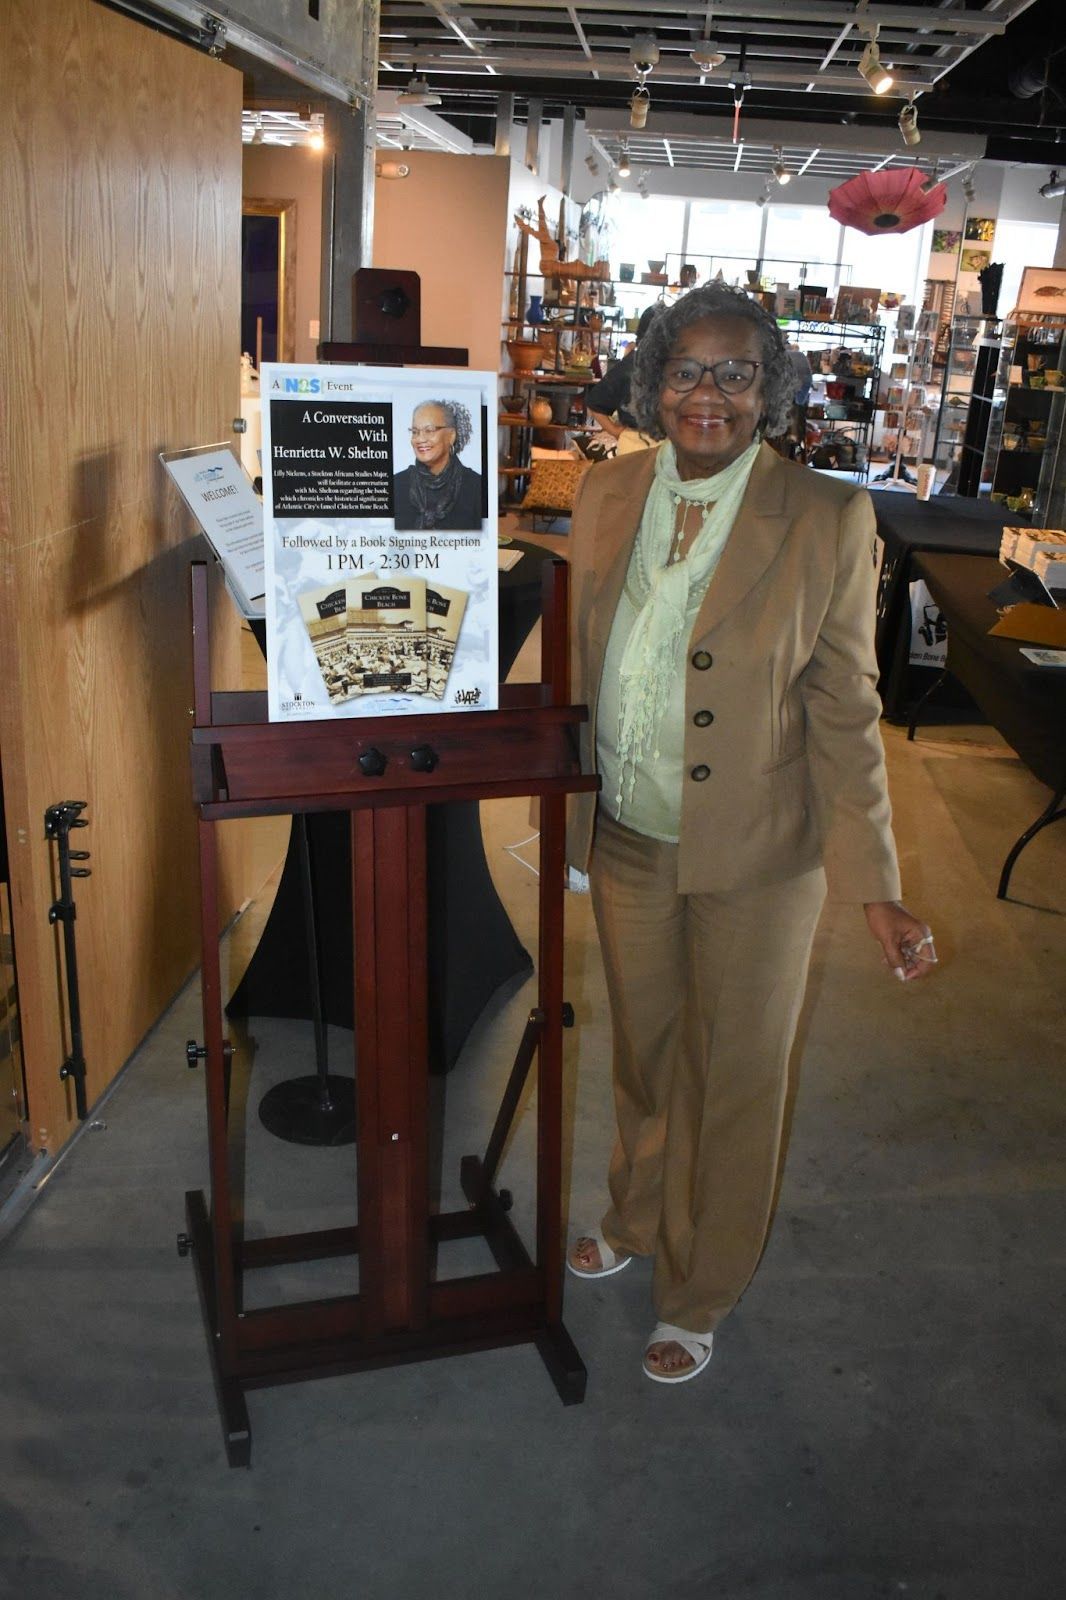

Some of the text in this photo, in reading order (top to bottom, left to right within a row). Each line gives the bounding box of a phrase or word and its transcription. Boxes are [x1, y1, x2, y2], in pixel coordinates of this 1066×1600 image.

[272, 378, 353, 393] A N2S Event
[302, 411, 385, 425] A Conversation
[358, 430, 388, 442] With
[273, 446, 389, 460] Henrietta W. Shelton
[273, 470, 285, 478] Lilly
[373, 471, 389, 479] Major,
[201, 484, 239, 502] WELCOME!
[340, 487, 364, 495] regarding
[303, 503, 320, 511] City's
[282, 535, 481, 550] Followed by a Book Signing Reception
[327, 554, 333, 570] 1
[338, 554, 364, 570] PM
[379, 554, 410, 570] 2:30
[414, 554, 440, 569] PM
